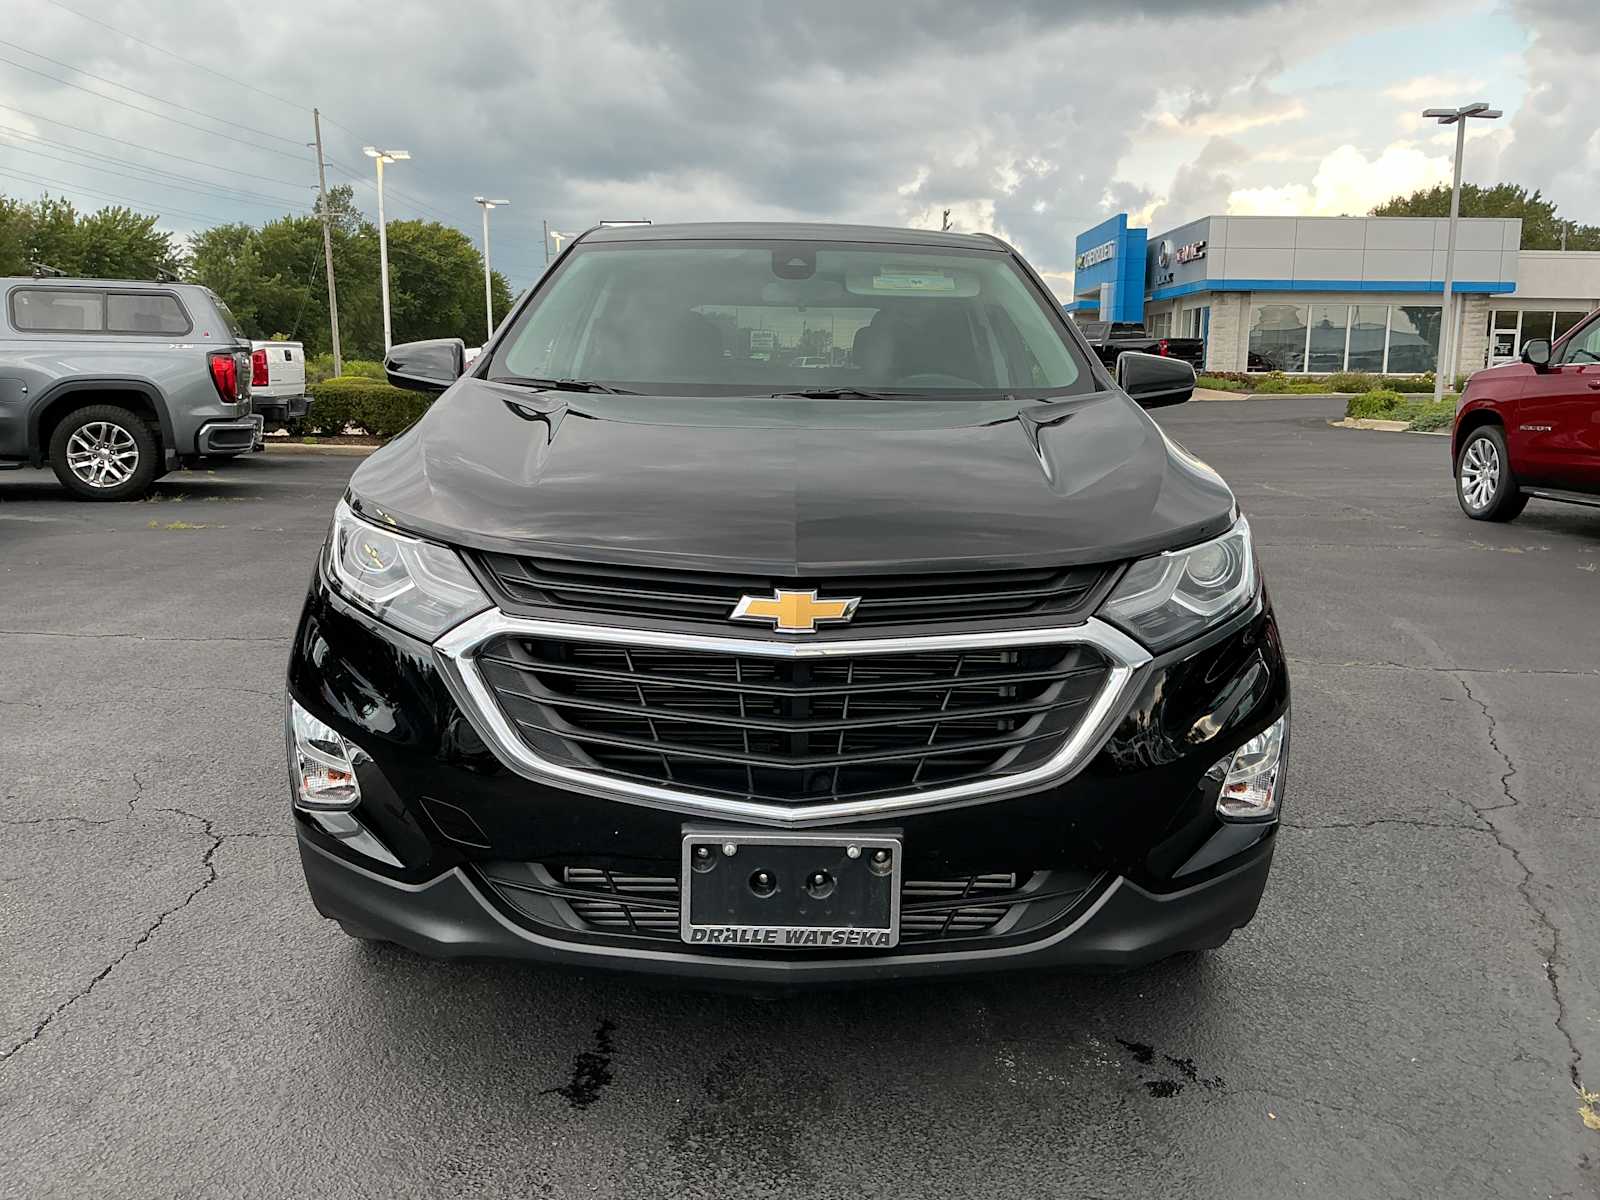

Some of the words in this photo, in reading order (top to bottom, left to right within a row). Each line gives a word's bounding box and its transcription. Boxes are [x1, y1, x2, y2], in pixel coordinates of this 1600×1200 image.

[1176, 240, 1206, 264] GMC
[690, 928, 778, 944] DRALLE
[785, 930, 890, 946] WATSEKA
